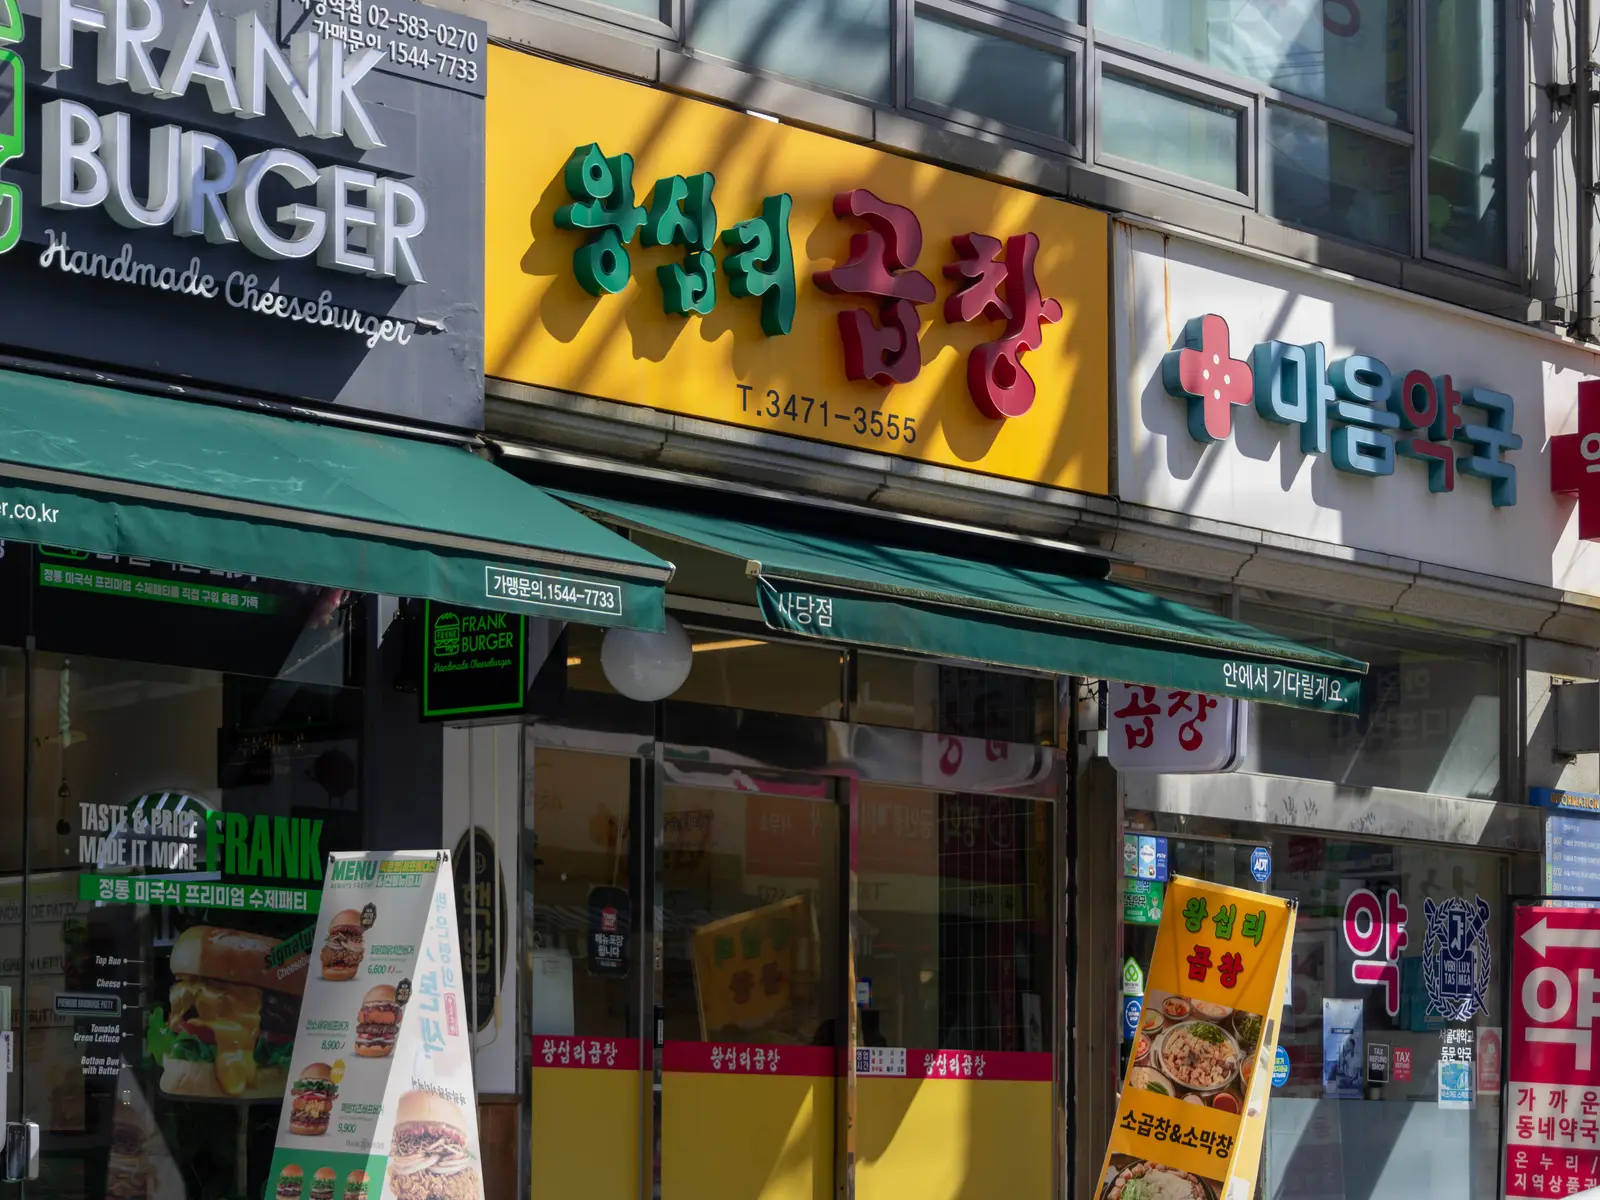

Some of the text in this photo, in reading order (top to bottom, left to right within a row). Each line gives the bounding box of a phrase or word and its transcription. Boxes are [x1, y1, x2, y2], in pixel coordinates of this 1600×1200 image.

[368, 4, 478, 53] 02-583-0270
[387, 40, 478, 82] 1544-7733
[41, 0, 387, 149] FRANK
[42, 99, 428, 286] BURGER
[39, 229, 411, 348] Handmade Cheeseburger
[552, 142, 1062, 419] 왕십리 곱창
[736, 384, 917, 445] T.3471-3555
[1253, 339, 1523, 508] 마음약국
[0, 501, 59, 523] r.co.kr
[461, 612, 508, 633] FRANK
[778, 591, 833, 628] 사당점
[461, 631, 514, 653] BURGER
[1223, 662, 1348, 703] 안에서 기다릴게요.
[1551, 792, 1599, 809] INFORMATION
[79, 802, 198, 839] TASTE & PRICE
[79, 835, 198, 871] MADE IT MORE
[206, 809, 324, 881] FRANK
[331, 859, 378, 881] MENU
[1254, 858, 1269, 872] ADT
[99, 878, 308, 911] 정통 미국식 프리미엄 수제패티
[1181, 896, 1266, 947] 왕십리
[264, 926, 316, 969] signatu
[1343, 888, 1408, 1017] 약
[95, 955, 122, 967] Top Bun
[1186, 944, 1244, 988] 곱창
[1443, 959, 1456, 973] VERI
[1458, 961, 1471, 974] LUX
[96, 978, 121, 989] Cheese
[1444, 973, 1456, 986] TAS
[1458, 973, 1471, 987] MEA
[1521, 966, 1600, 1071] 약
[73, 1032, 120, 1043] Green Lettuce
[1439, 1028, 1475, 1046] 서울대학교
[540, 1039, 618, 1067] 왕십리곱창
[710, 1046, 781, 1072] 왕십리곱창
[856, 1050, 869, 1061] 영업
[1369, 1055, 1388, 1064] REFUND
[1373, 1047, 1384, 1055] TAX
[1395, 1051, 1411, 1062] TAX
[1440, 1046, 1472, 1065] 동문 약국
[856, 1061, 869, 1071] 시간
[923, 1053, 987, 1078] 왕십리곱창
[1371, 1063, 1386, 1071] SHOP
[1120, 1109, 1234, 1159] 소곱창&소막창
[1515, 1115, 1600, 1143] 동네약국
